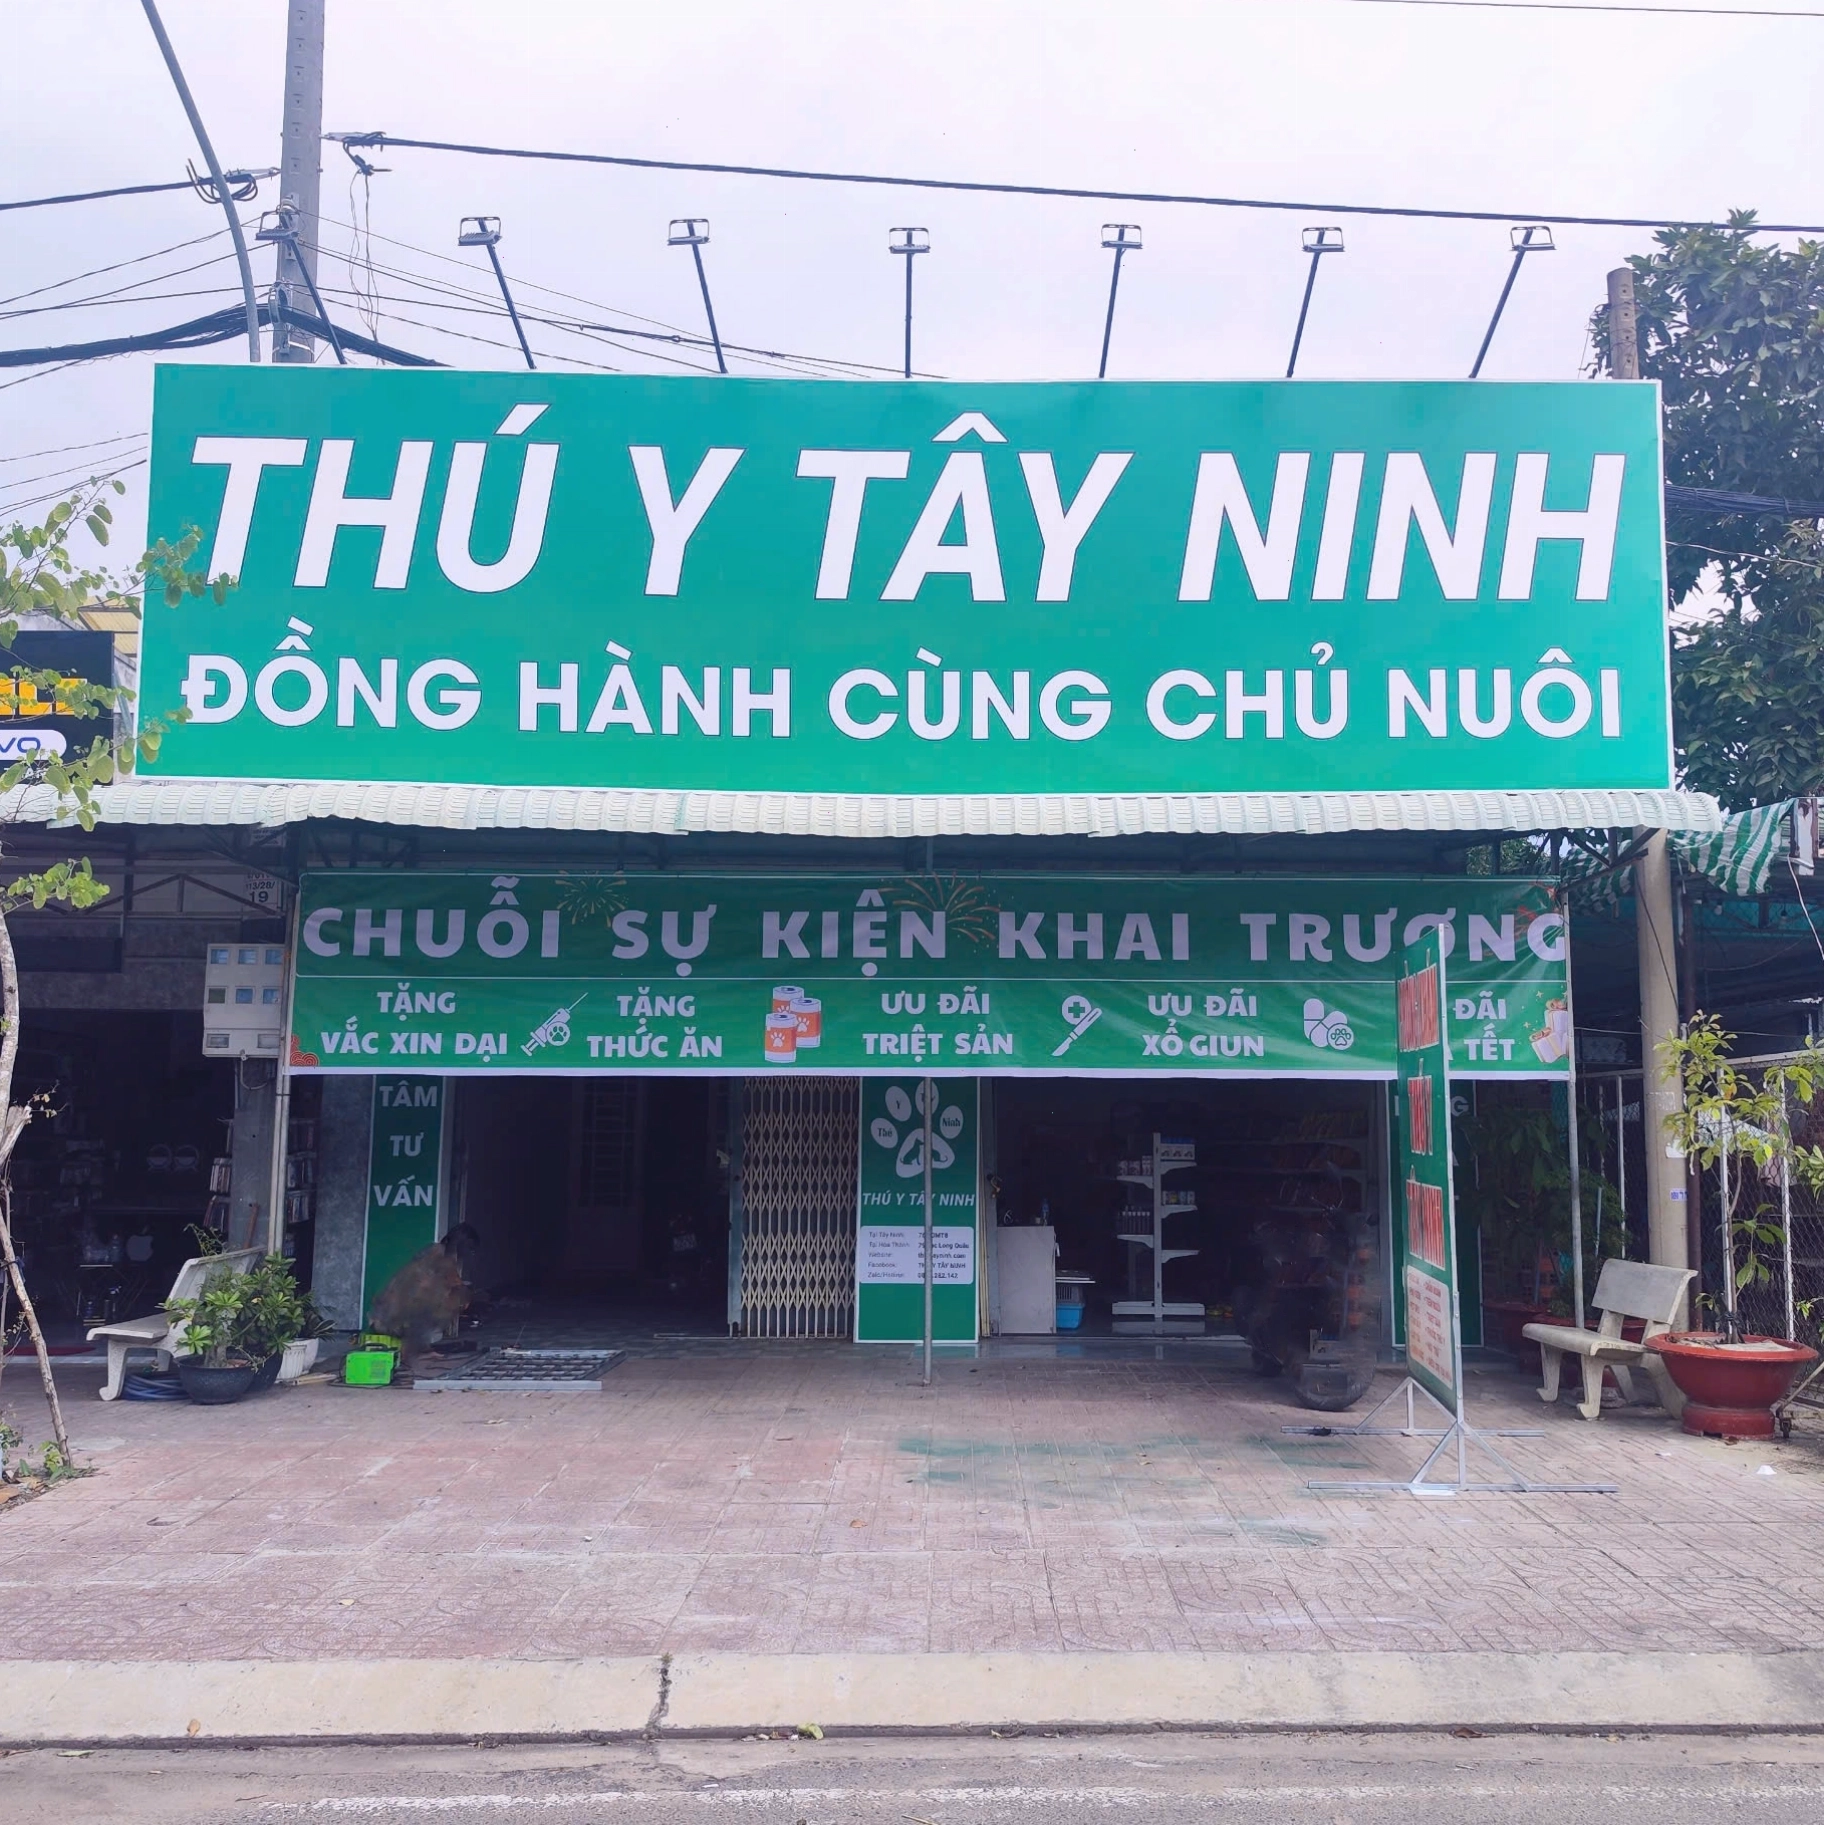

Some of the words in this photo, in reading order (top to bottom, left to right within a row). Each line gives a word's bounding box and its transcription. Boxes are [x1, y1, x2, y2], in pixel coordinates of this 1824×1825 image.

[192, 404, 560, 593] THÚ
[628, 446, 745, 596] Y
[796, 412, 1134, 602] TÂY
[1178, 452, 1626, 601] NINH
[181, 617, 482, 731] ĐỒNG
[519, 641, 791, 737] HÀNH
[828, 648, 1112, 741] CÙNG
[1146, 642, 1348, 740] CHỦ
[1388, 647, 1622, 739] NUÔI
[249, 890, 269, 903] 19
[303, 876, 560, 959] CHUỖI
[611, 904, 718, 978] SỰ
[761, 888, 947, 977] KIỆN
[998, 911, 1190, 961] KHAI
[377, 983, 456, 1021] TẶNG
[617, 987, 696, 1025] TẶNG
[881, 991, 926, 1015] ƯU
[937, 985, 990, 1015] ĐÃI
[1148, 992, 1192, 1016] ƯU
[1204, 988, 1257, 1017] ĐÃI
[1453, 990, 1507, 1020] ĐÃI
[321, 1015, 379, 1055] VẮC
[390, 1032, 443, 1055] XIN
[455, 1032, 508, 1062] DẠI
[587, 1024, 669, 1058] THỨC
[679, 1027, 723, 1058] ĂN
[863, 1024, 943, 1063] TRIỆT
[955, 1023, 1014, 1055] SẢN
[1142, 1018, 1184, 1056] XỔ
[1189, 1035, 1265, 1057] GIUN
[1464, 1023, 1513, 1061] TẾT
[379, 1080, 438, 1107] TÂM
[390, 1132, 425, 1157] TƯ
[373, 1174, 434, 1207] VẤN
[862, 1190, 892, 1206] THÚ
[896, 1193, 905, 1206] Y
[939, 1193, 976, 1207] NINH
